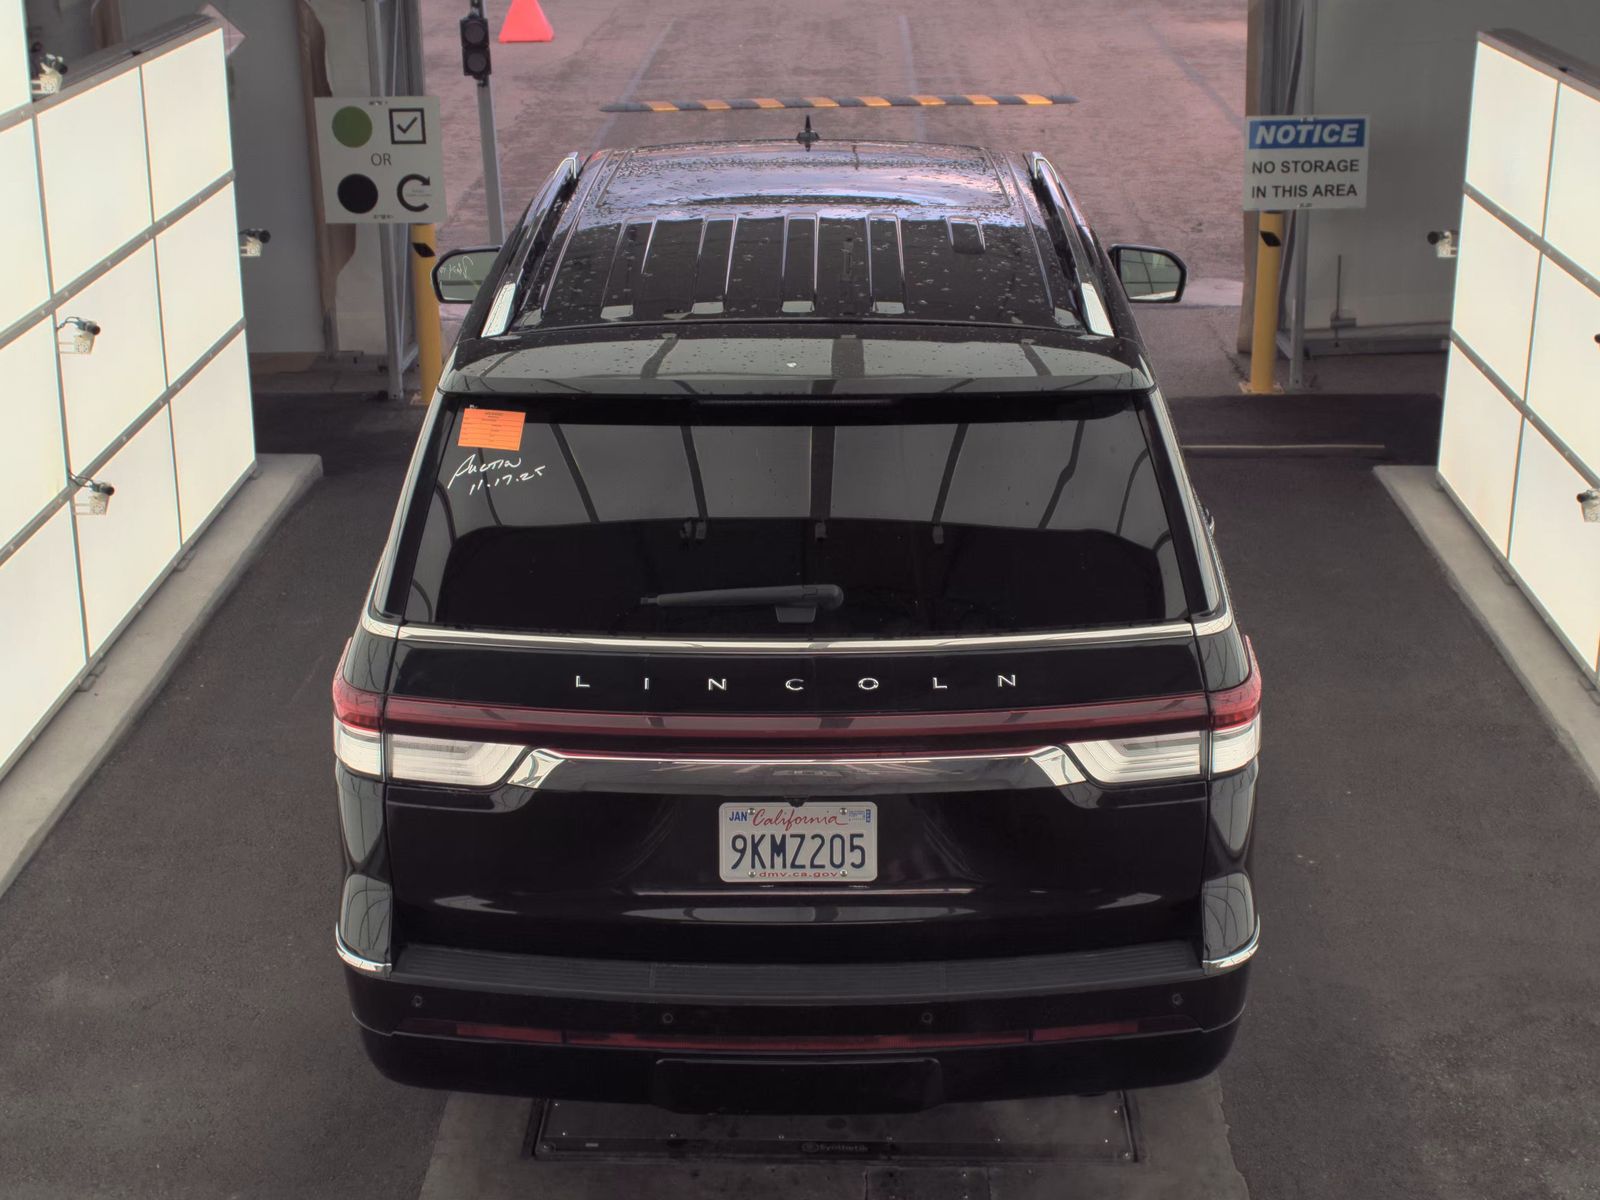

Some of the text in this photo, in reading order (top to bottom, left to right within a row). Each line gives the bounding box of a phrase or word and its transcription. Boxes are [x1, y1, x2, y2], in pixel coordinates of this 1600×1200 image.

[1255, 124, 1359, 144] NOTICE
[370, 152, 392, 166] OR
[1252, 159, 1360, 174] NO STORAGE
[1252, 183, 1357, 198] IN THIS AREA
[575, 674, 1017, 691] LINCOLN
[729, 811, 748, 821] JAN
[752, 808, 849, 831] California
[731, 833, 866, 869] 9KMZ205
